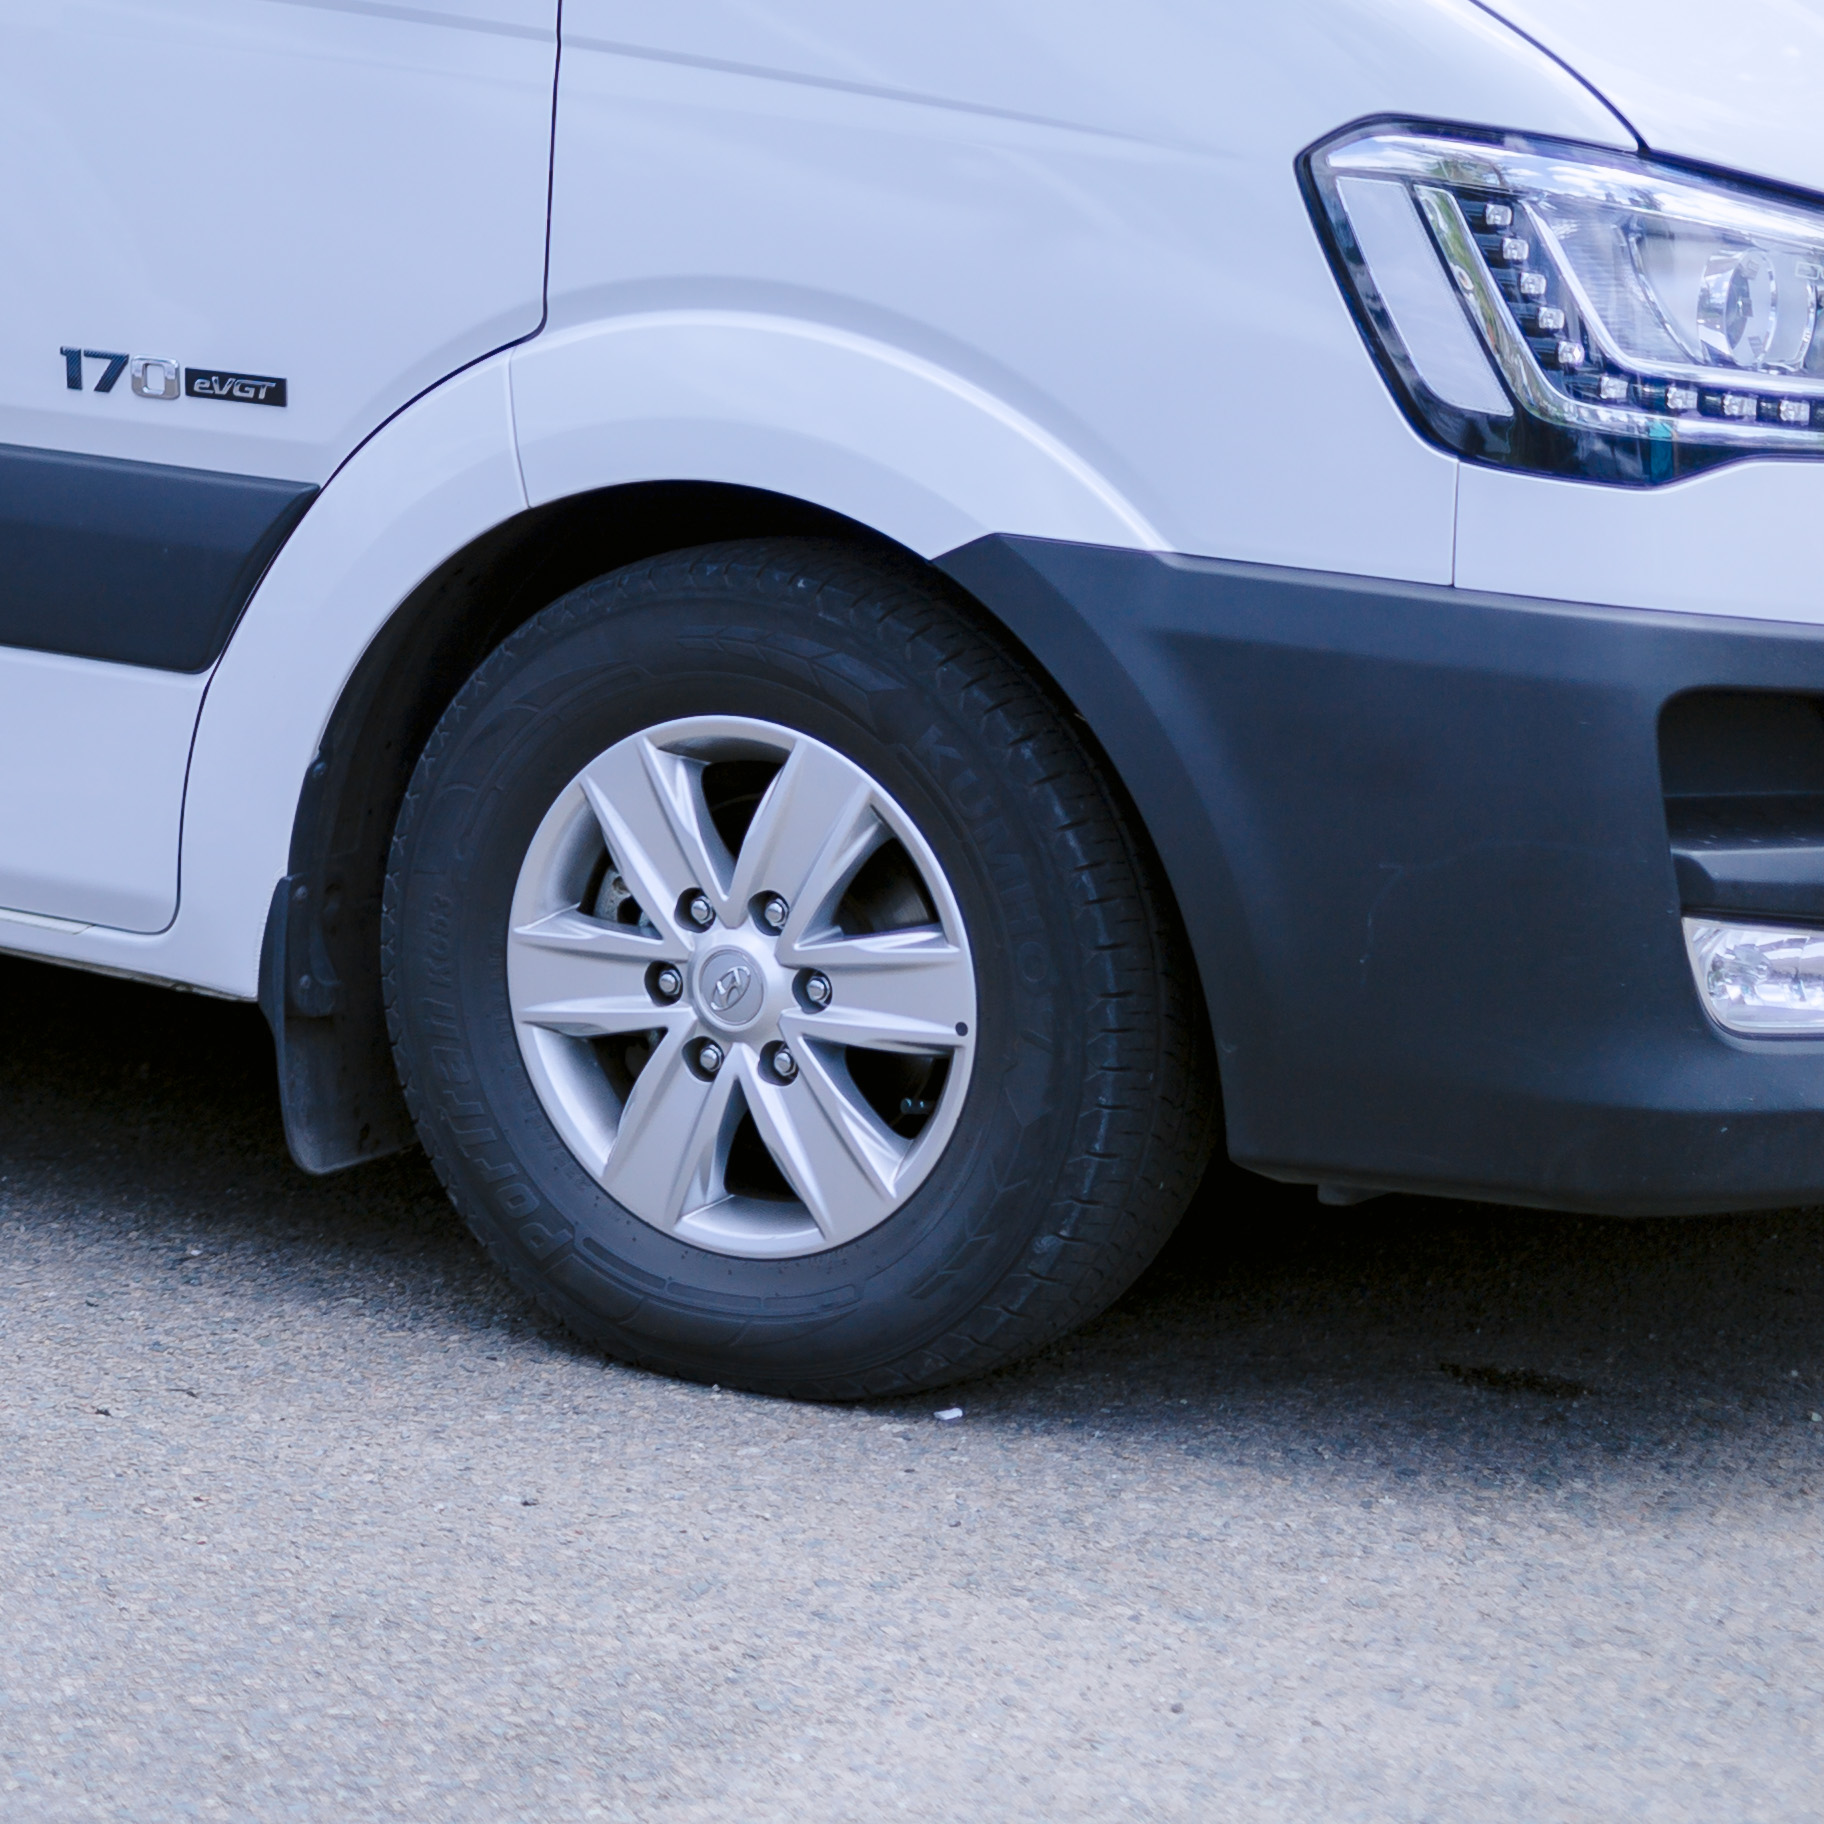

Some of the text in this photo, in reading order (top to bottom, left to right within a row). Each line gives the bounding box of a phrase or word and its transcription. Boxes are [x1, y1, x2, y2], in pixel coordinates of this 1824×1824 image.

[60, 346, 276, 400] 170 eVGT
[914, 723, 1052, 984] KUMHO
